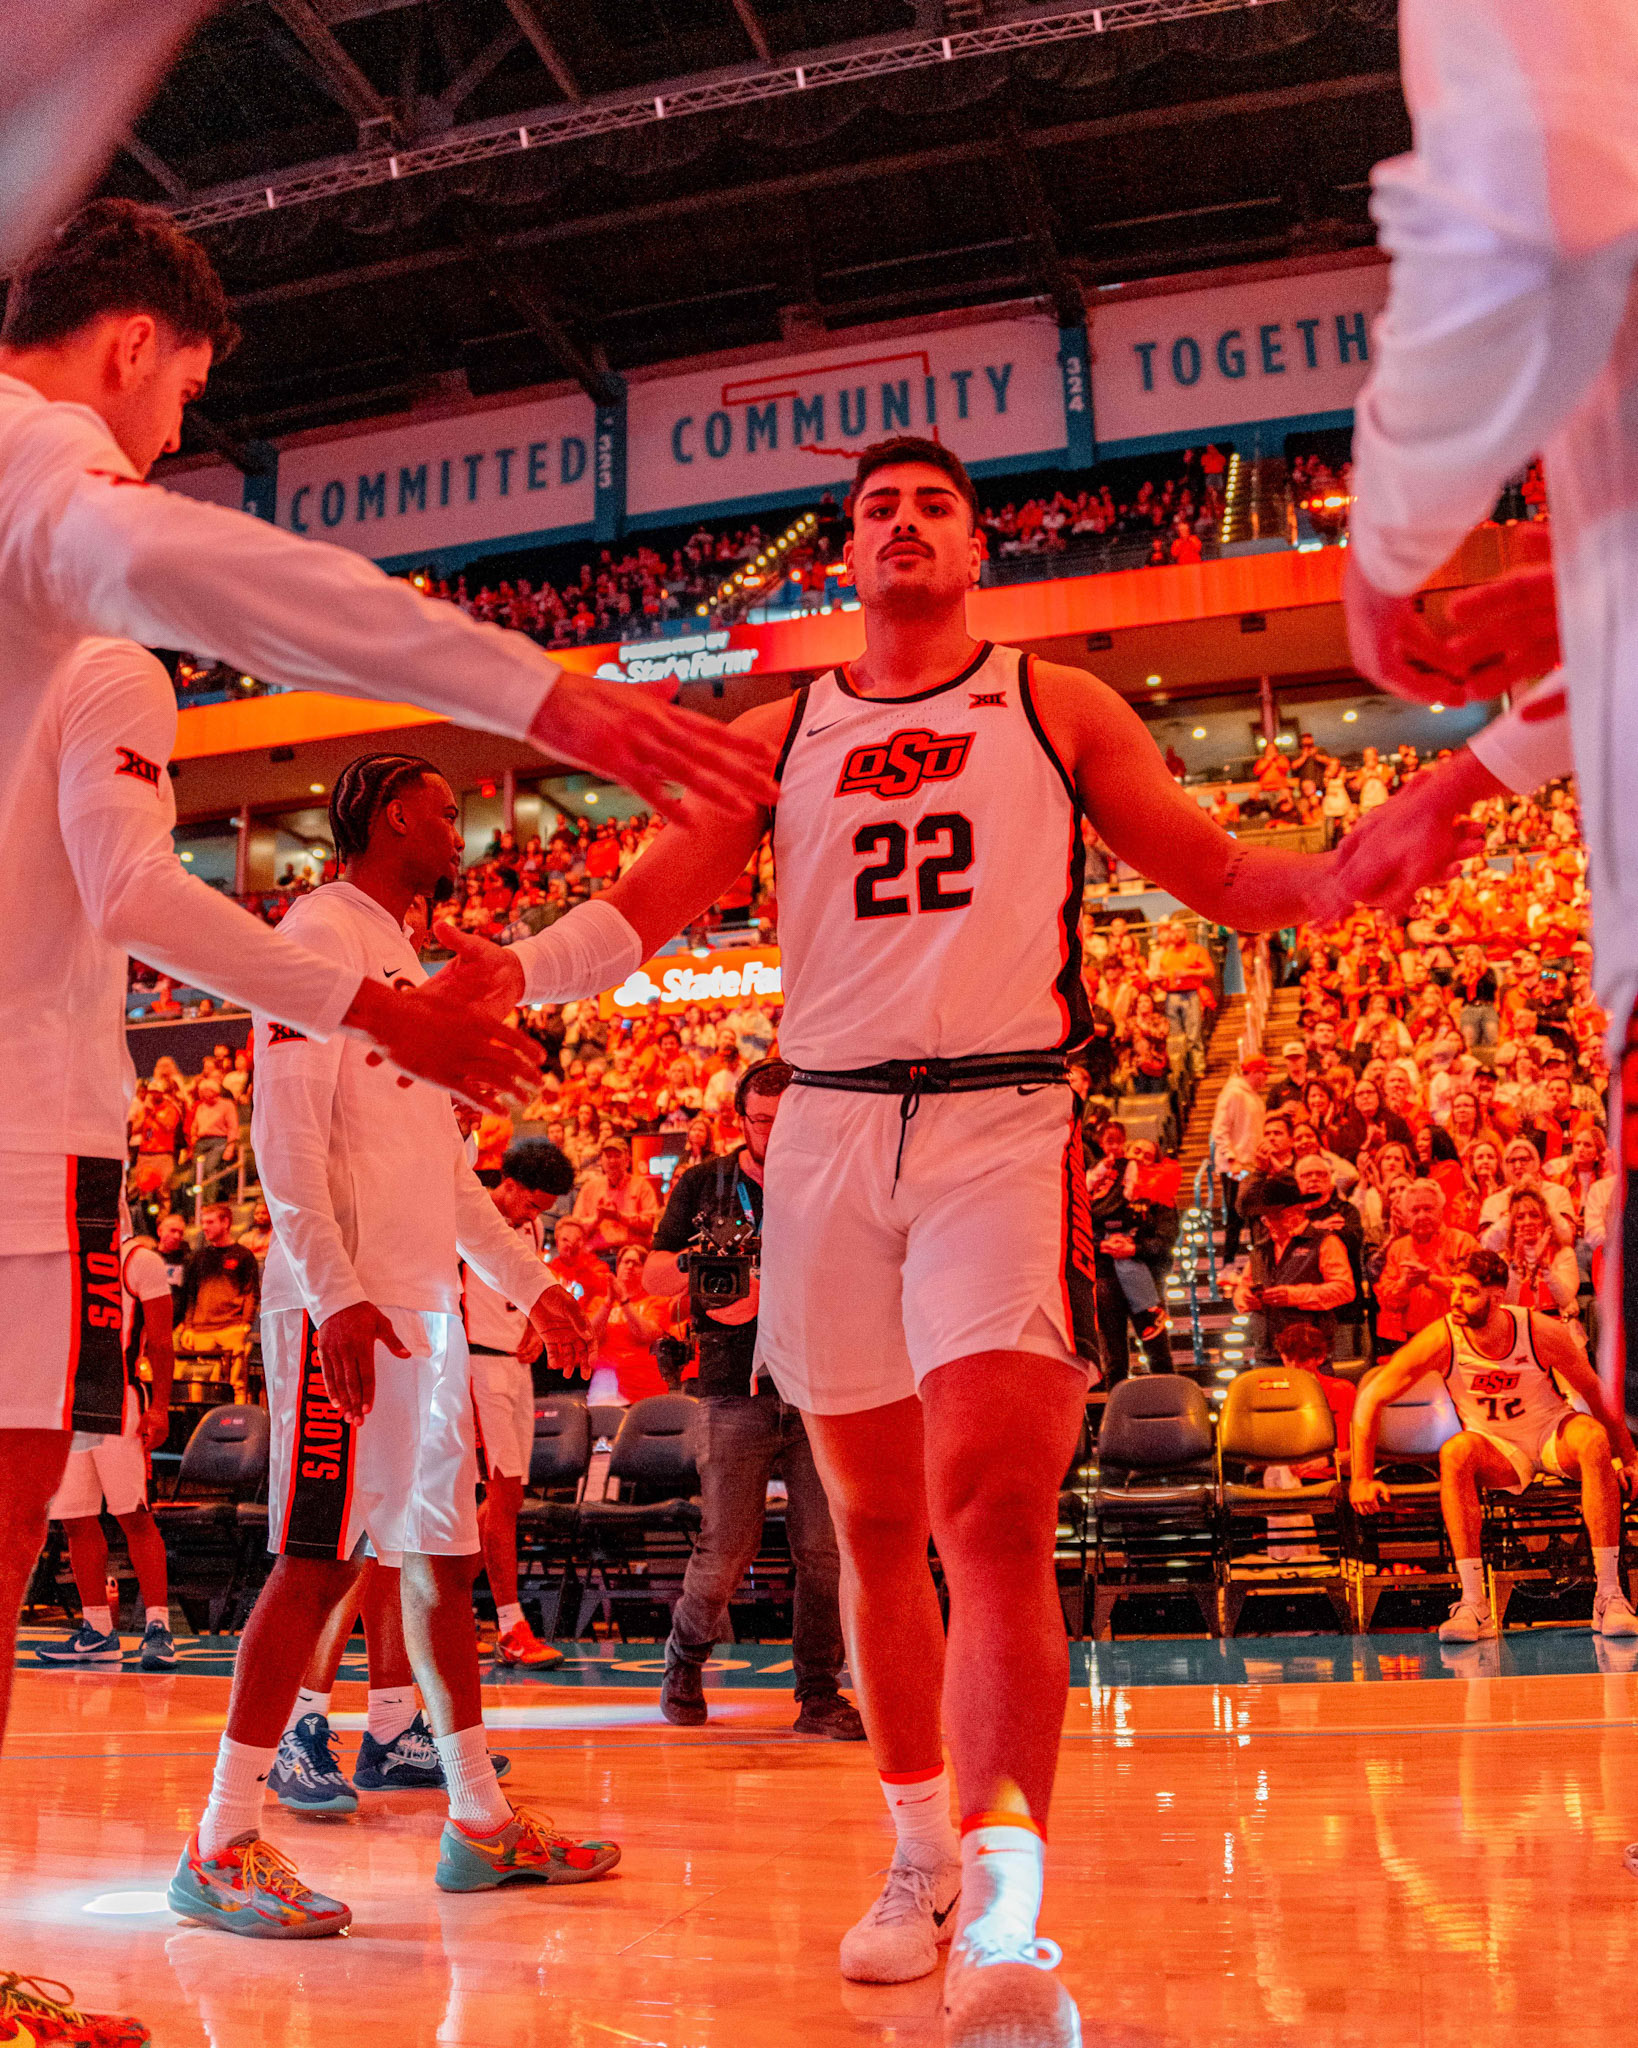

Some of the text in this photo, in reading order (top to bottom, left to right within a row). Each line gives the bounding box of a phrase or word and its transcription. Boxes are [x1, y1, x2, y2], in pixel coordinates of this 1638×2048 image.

[670, 363, 1013, 465] COMMUNITY
[289, 436, 588, 534] COMMITTED
[968, 691, 1008, 709] XII
[834, 728, 977, 801] OSU
[851, 811, 976, 921] 22
[660, 965, 741, 1003] State
[1470, 1371, 1521, 1394] OSU
